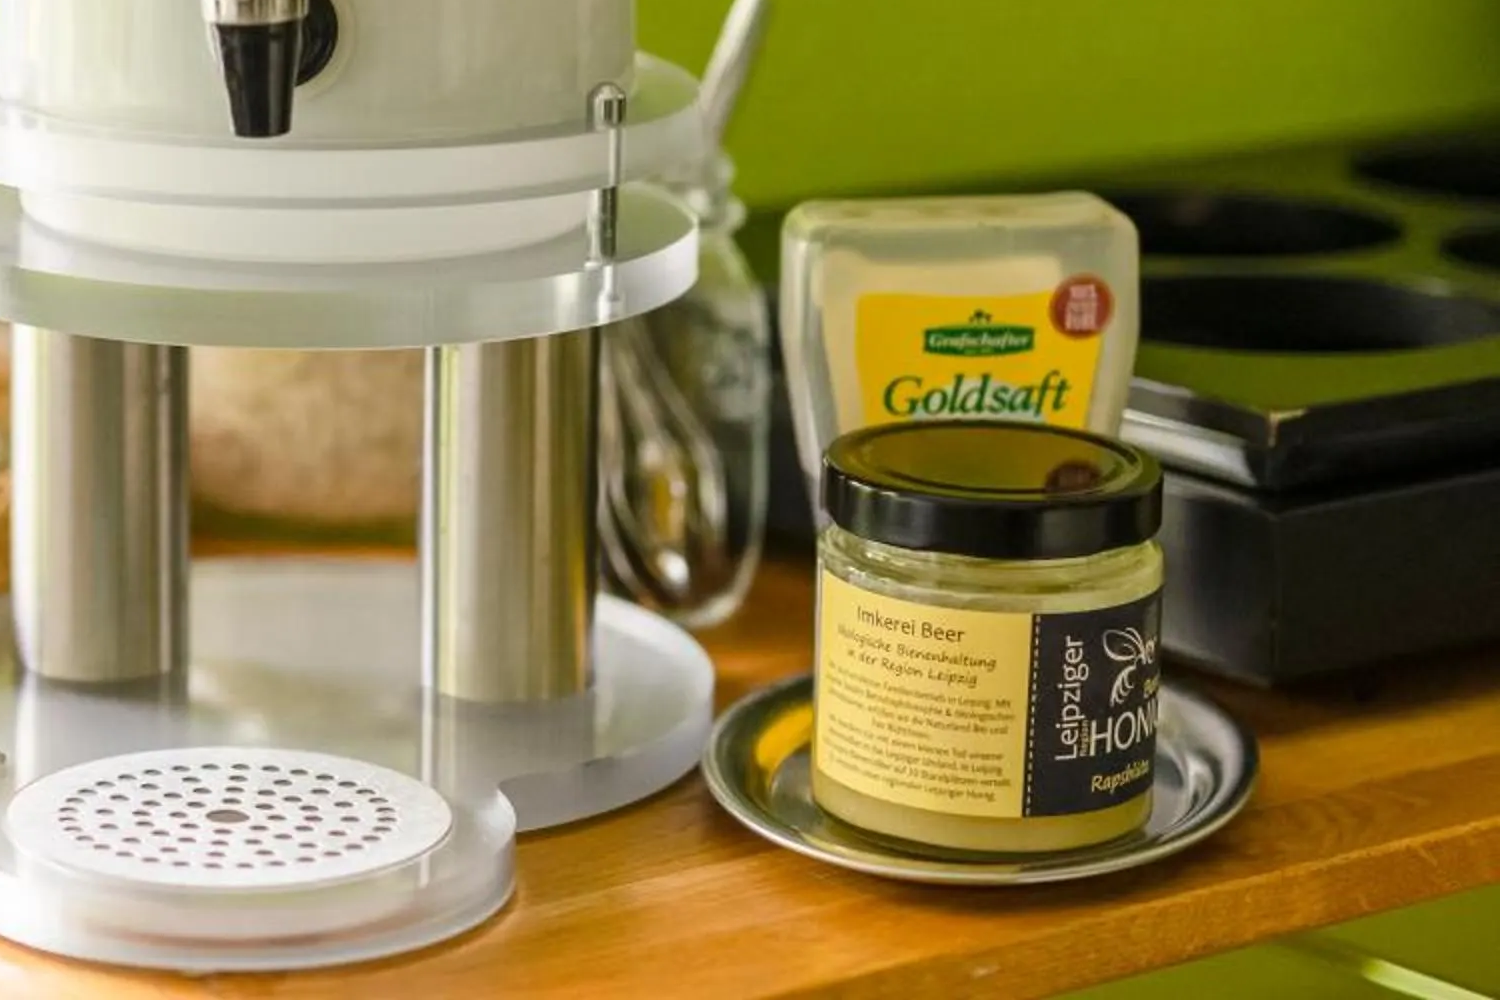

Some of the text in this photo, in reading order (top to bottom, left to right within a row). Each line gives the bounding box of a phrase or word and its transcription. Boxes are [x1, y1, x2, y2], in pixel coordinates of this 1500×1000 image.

[882, 369, 1073, 418] Goldsaft
[856, 605, 966, 643] Imkerei Beer
[880, 657, 923, 677] Region
[927, 668, 978, 689] Leipzig
[896, 642, 997, 672] Bienenhaltung
[1053, 635, 1090, 761] Leipziger
